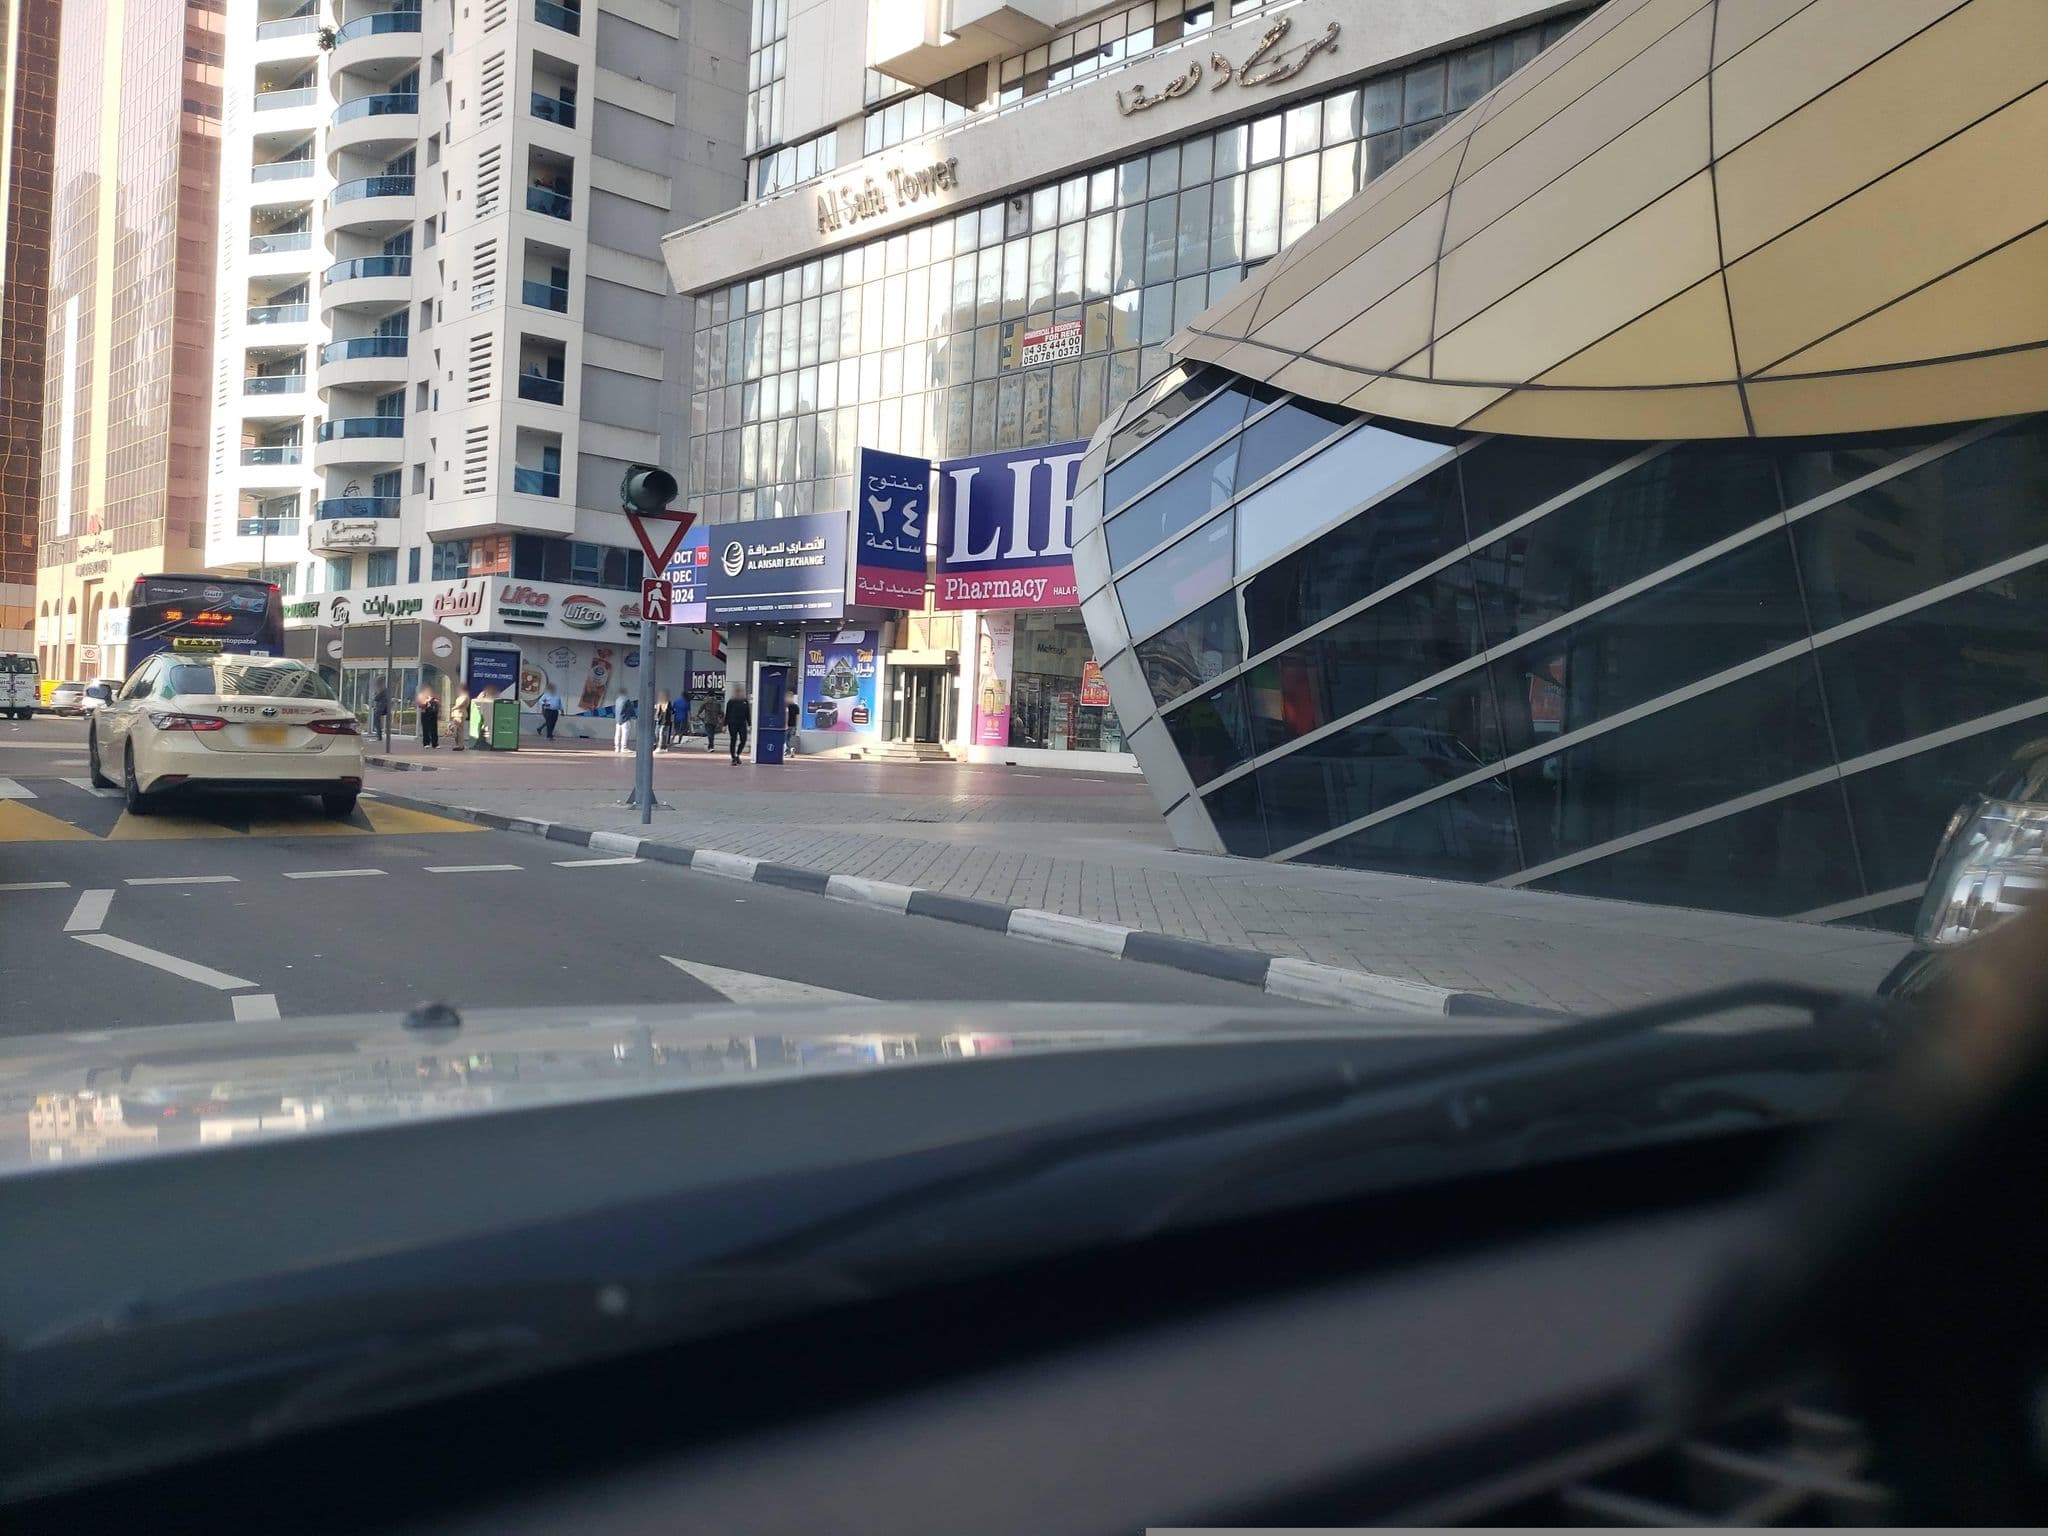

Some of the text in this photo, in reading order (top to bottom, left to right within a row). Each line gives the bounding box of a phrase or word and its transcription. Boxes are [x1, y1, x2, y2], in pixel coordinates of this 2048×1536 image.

[841, 176, 888, 225] Safa
[886, 157, 959, 207] Tower
[1044, 328, 1081, 342] FOR RENT
[1036, 344, 1047, 353] 35
[1049, 340, 1066, 349] 444
[1068, 336, 1081, 346] 00
[1024, 345, 1080, 365] 050 781 0373
[868, 474, 924, 492] مفتوح
[868, 494, 921, 538] ٢٤
[747, 536, 826, 556] الأنصاري للصرافة
[866, 532, 921, 554] ساعة
[674, 551, 693, 564] OCT
[698, 552, 707, 560] TO
[747, 555, 826, 570] AL ANSARI EXCHANGE
[673, 570, 692, 583] DEC
[858, 576, 925, 597] صيدلية
[945, 577, 1048, 602] Pharmacy
[1053, 586, 1071, 596] HALA
[500, 584, 550, 607] Lifco
[672, 588, 694, 603] 2024
[565, 605, 604, 622] Lifco
[692, 672, 705, 688] hot
[807, 668, 826, 677] HOME
[216, 705, 229, 713] AT
